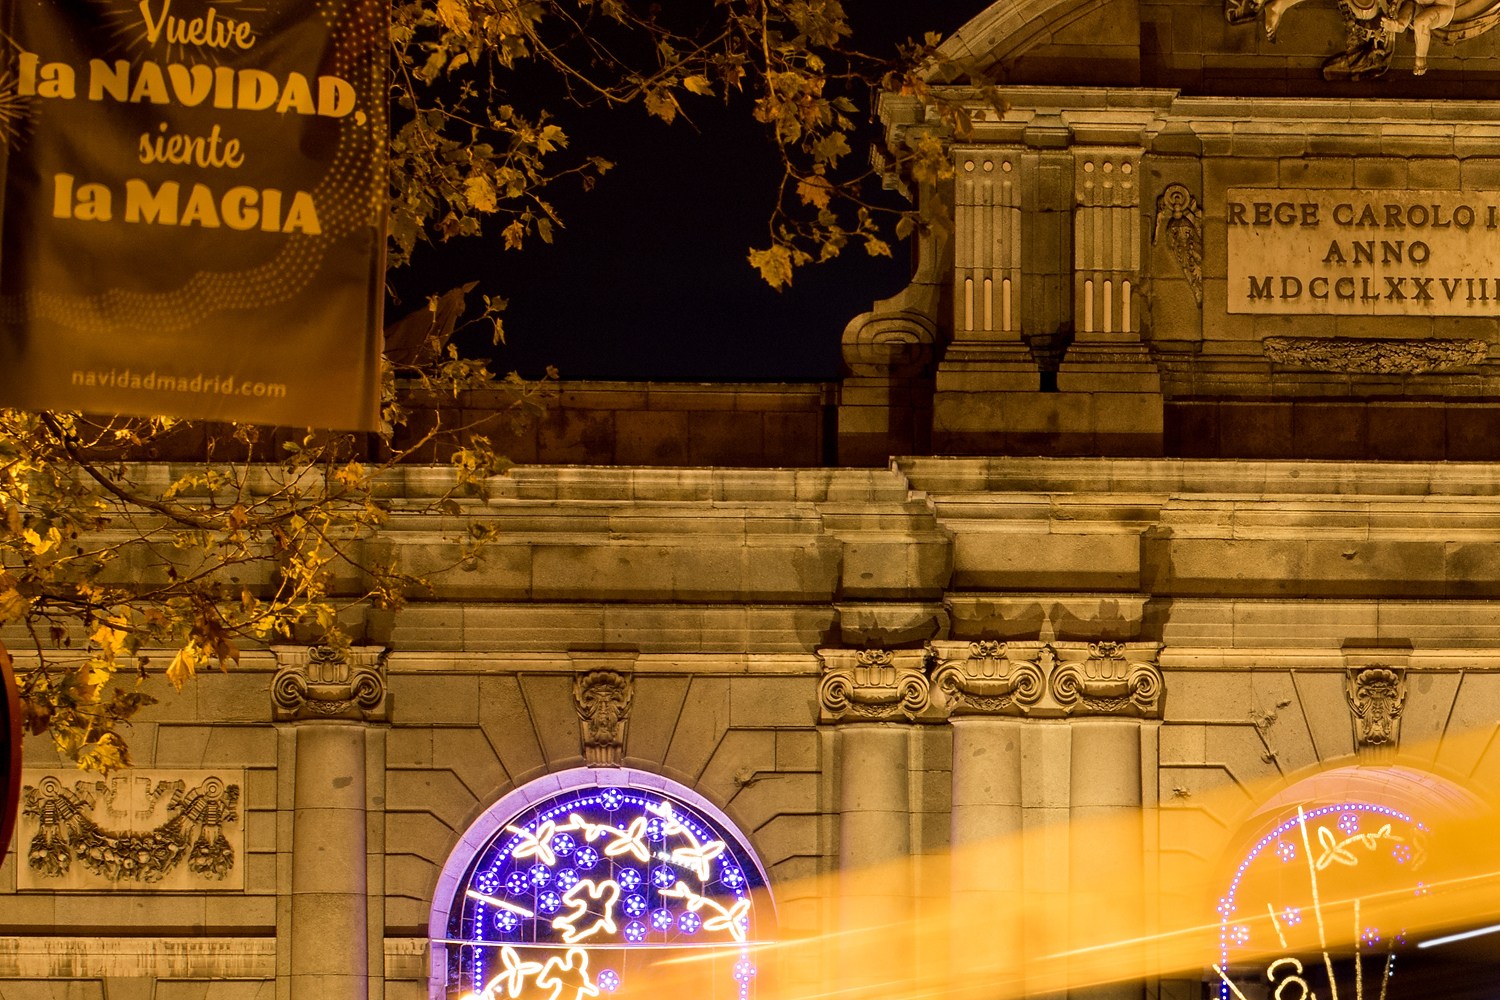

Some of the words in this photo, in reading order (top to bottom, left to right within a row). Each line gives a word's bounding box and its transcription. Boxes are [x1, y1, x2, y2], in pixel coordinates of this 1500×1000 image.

[139, 0, 256, 49] Vuelve
[18, 52, 76, 99] la
[89, 59, 367, 126] NAVIDAD,
[139, 122, 245, 168] siente
[53, 173, 112, 221] la
[125, 178, 322, 235] MAGIA
[1227, 202, 1320, 226] REGE
[1332, 203, 1475, 228] CAROLO
[1322, 240, 1430, 264] ANNO
[71, 368, 287, 399] navidadmadrid.com
